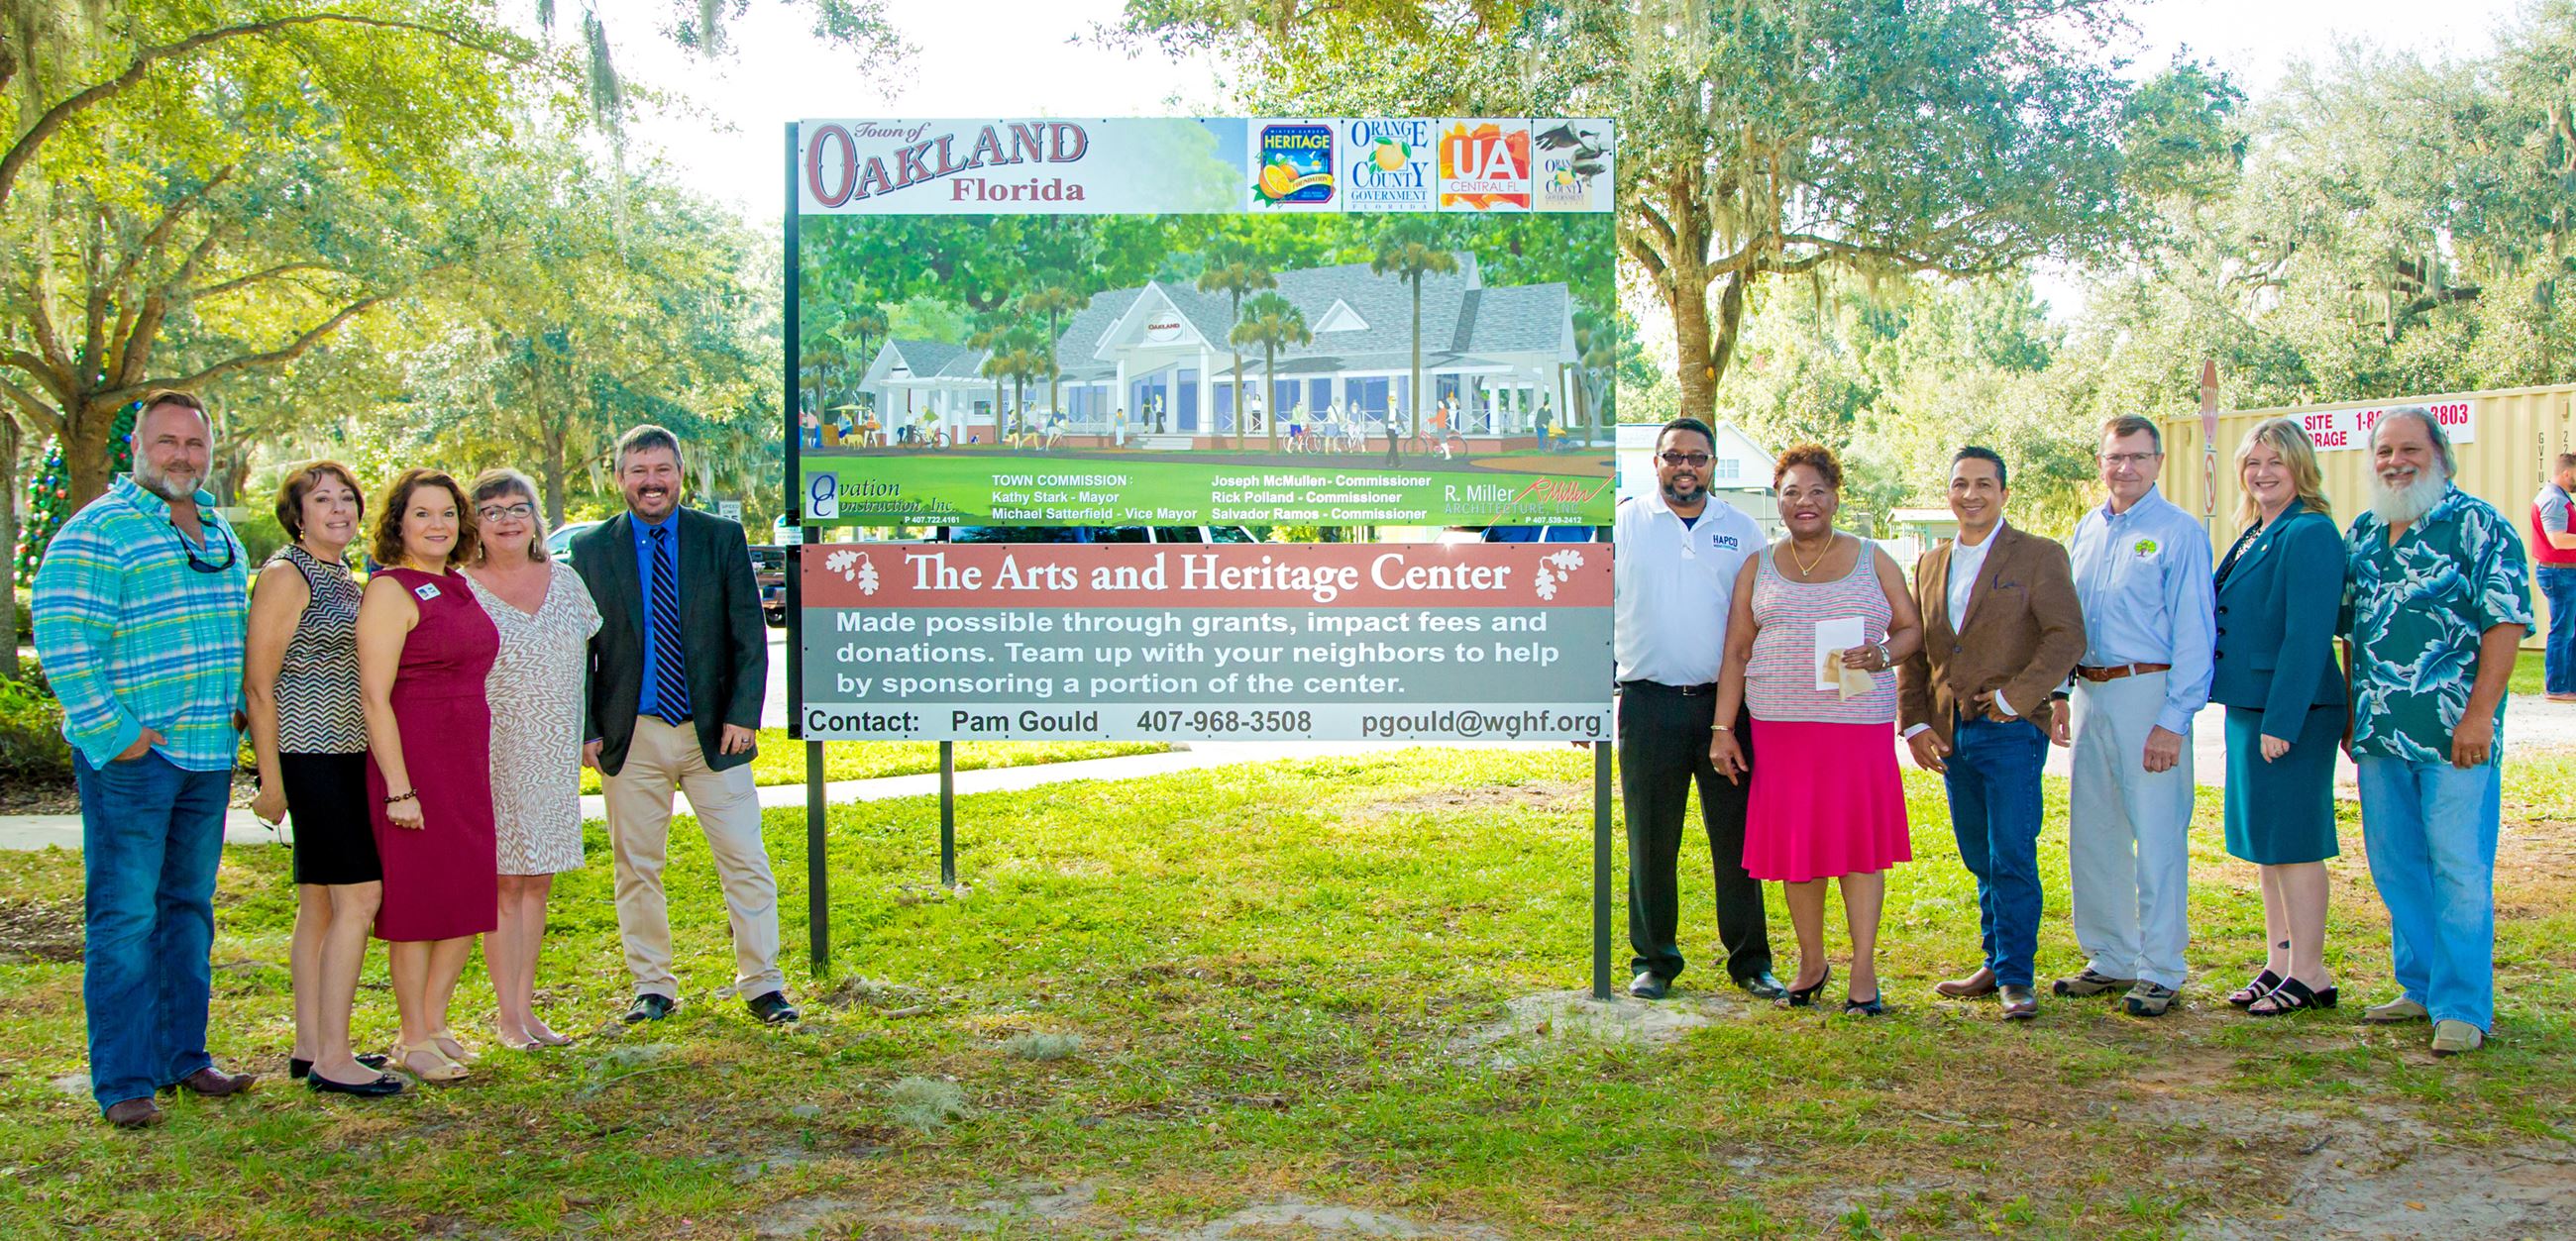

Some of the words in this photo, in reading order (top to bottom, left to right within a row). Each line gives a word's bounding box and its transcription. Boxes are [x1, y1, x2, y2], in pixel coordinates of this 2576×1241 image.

[854, 122, 904, 138] Town
[906, 121, 931, 144] of
[1351, 120, 1428, 148] ORANGE
[1264, 135, 1330, 149] HERITAGE
[805, 121, 1089, 208] OAKLAND
[1453, 140, 1520, 179] UA
[1352, 161, 1428, 187] COUNTY
[950, 178, 1085, 201] Florida
[1450, 181, 1503, 192] CENTRAL
[1508, 181, 1519, 192] FL
[1351, 190, 1427, 200] GOVERNMENT
[2305, 414, 2333, 430] SITE
[992, 474, 1032, 486] TOWN
[1211, 474, 1260, 489] Joseph
[1336, 474, 1431, 487] Commissioner
[993, 491, 1031, 505] Kathy
[1033, 491, 1068, 503] Stark
[1079, 491, 1119, 505] Mayor
[1212, 491, 1240, 503] Rick
[1244, 491, 1294, 503] Polland
[1306, 491, 1402, 503] Commissioner
[1445, 485, 1460, 501] R.
[1466, 485, 1515, 501] Miller
[930, 497, 957, 512] Inc.
[1556, 503, 1584, 514] INC.
[993, 507, 1042, 519] Michael
[1045, 507, 1113, 520] Satterfield
[1127, 508, 1152, 520] Vice
[1156, 508, 1198, 523] Mayor
[1211, 507, 1270, 520] Salvador
[1273, 508, 1319, 520] Ramos
[1331, 507, 1427, 520] Commissioner
[1713, 535, 1738, 548] HAPCO
[905, 552, 982, 590] The
[992, 554, 1078, 590] Arts
[1090, 552, 1168, 590] and
[1180, 554, 1358, 602] Heritage
[1371, 554, 1511, 590] Center
[836, 612, 915, 632] Made
[926, 612, 1052, 637] possible
[1063, 612, 1181, 637] through
[1192, 613, 1297, 637] grants,
[1308, 612, 1409, 637] impact
[1418, 612, 1481, 632] fees
[1491, 612, 1547, 632] and
[836, 643, 995, 663] donations.
[1005, 643, 1084, 663] Team
[1095, 648, 1131, 668] up
[1141, 643, 1204, 663] with
[1215, 648, 1283, 668] your
[1293, 643, 1446, 668] neighbors
[1456, 645, 1484, 663] to
[1495, 643, 1559, 668] help
[836, 673, 872, 697] by
[882, 673, 1053, 697] sponsoring
[1063, 678, 1080, 693] a
[1090, 673, 1197, 697] portion
[1208, 673, 1238, 693] of
[1246, 673, 1294, 693] the
[1303, 675, 1405, 693] center.
[808, 710, 919, 732] Contact:
[952, 711, 1009, 732] Pam
[1019, 710, 1098, 732] Gould
[1136, 710, 1312, 732] 407-968-3508
[1362, 710, 1601, 737] pgould@wghf.org
